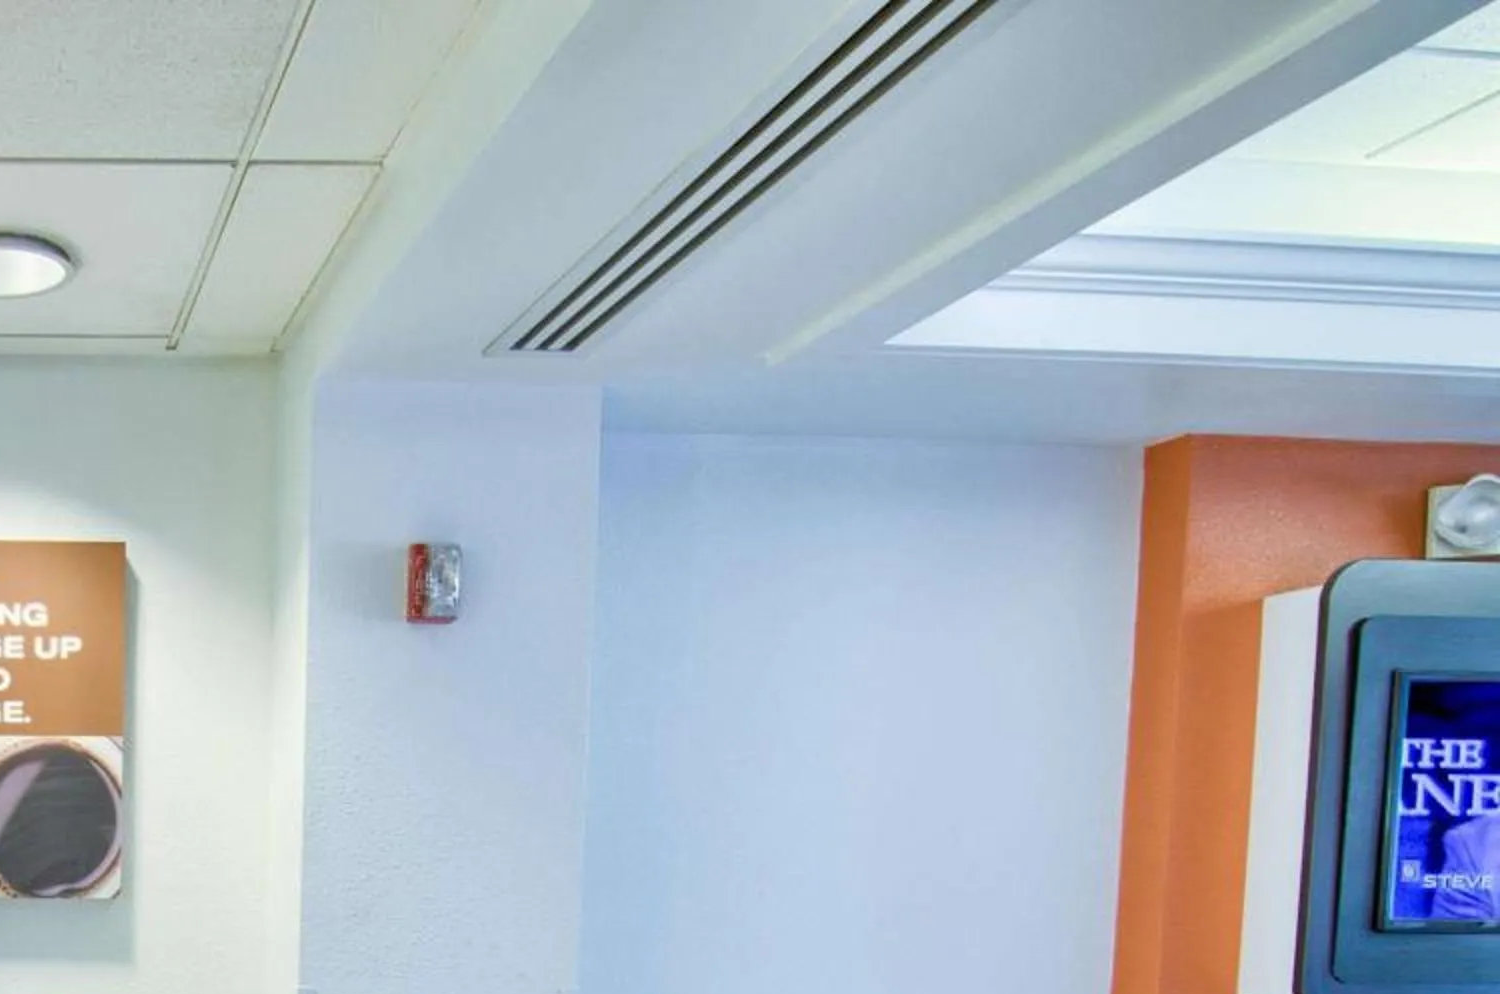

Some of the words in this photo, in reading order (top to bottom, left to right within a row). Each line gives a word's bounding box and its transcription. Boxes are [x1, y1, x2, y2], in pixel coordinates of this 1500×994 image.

[33, 636, 83, 660] UP
[1402, 738, 1485, 768] THE
[1423, 873, 1493, 889] STEVE
